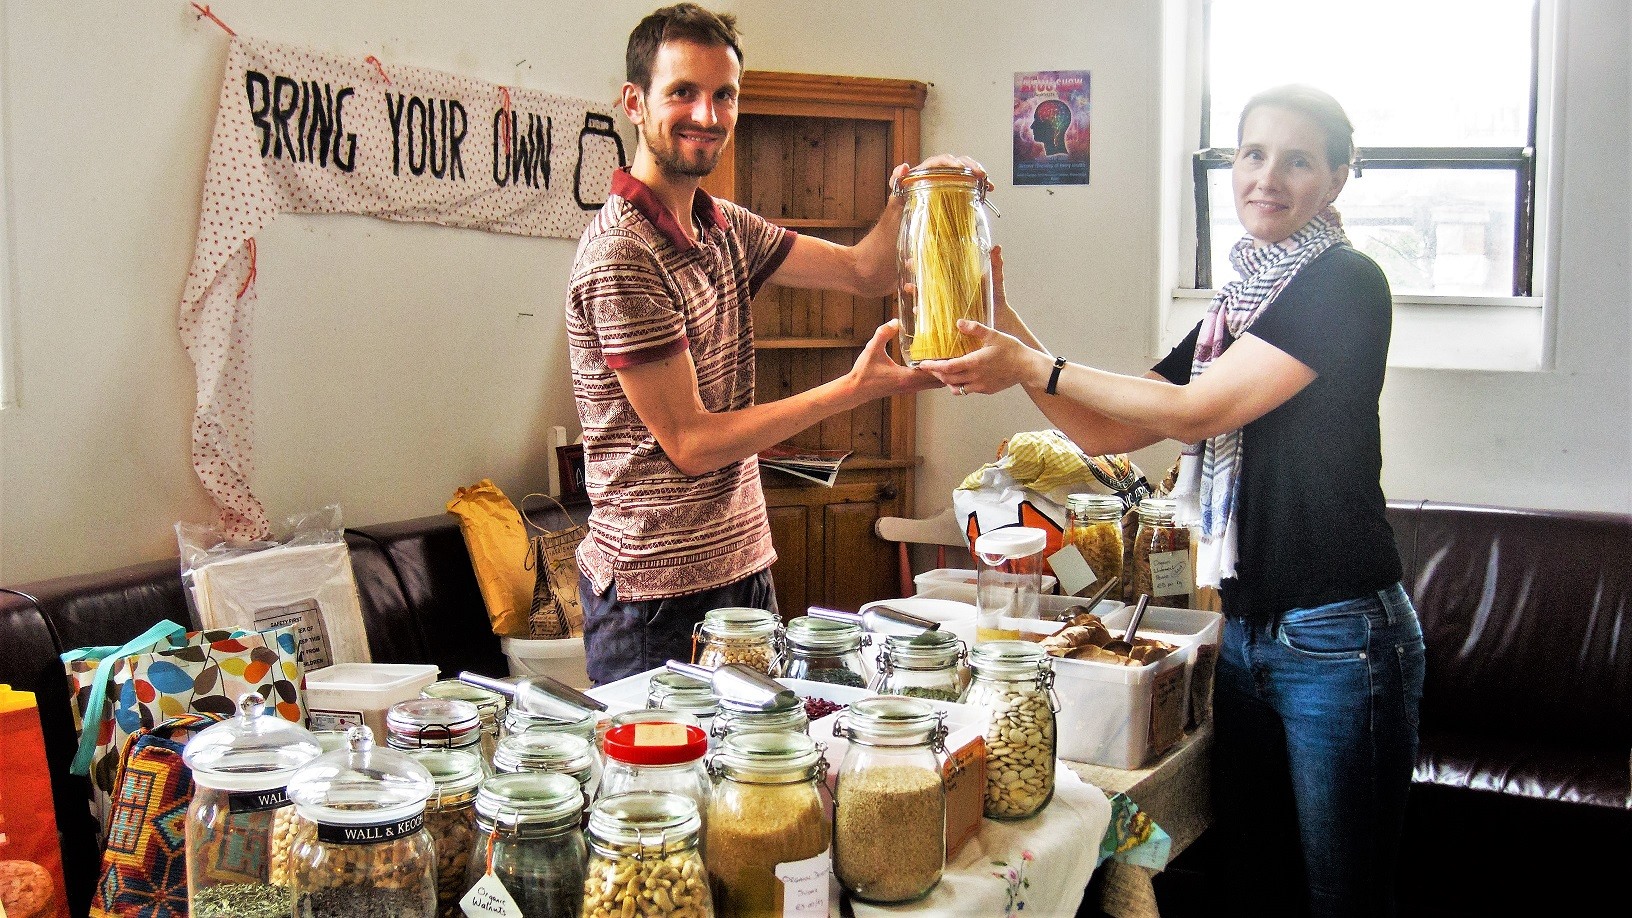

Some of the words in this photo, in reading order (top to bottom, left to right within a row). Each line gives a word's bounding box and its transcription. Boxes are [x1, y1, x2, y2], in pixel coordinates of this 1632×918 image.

[246, 70, 356, 173] BRING
[385, 92, 468, 181] YOUR
[492, 106, 552, 191] OWN
[270, 619, 288, 628] SAFETY
[289, 616, 302, 624] FIRST
[344, 827, 383, 840] WALL
[385, 827, 394, 837] &
[477, 886, 506, 906] Organic
[472, 896, 507, 917] Walnuts
